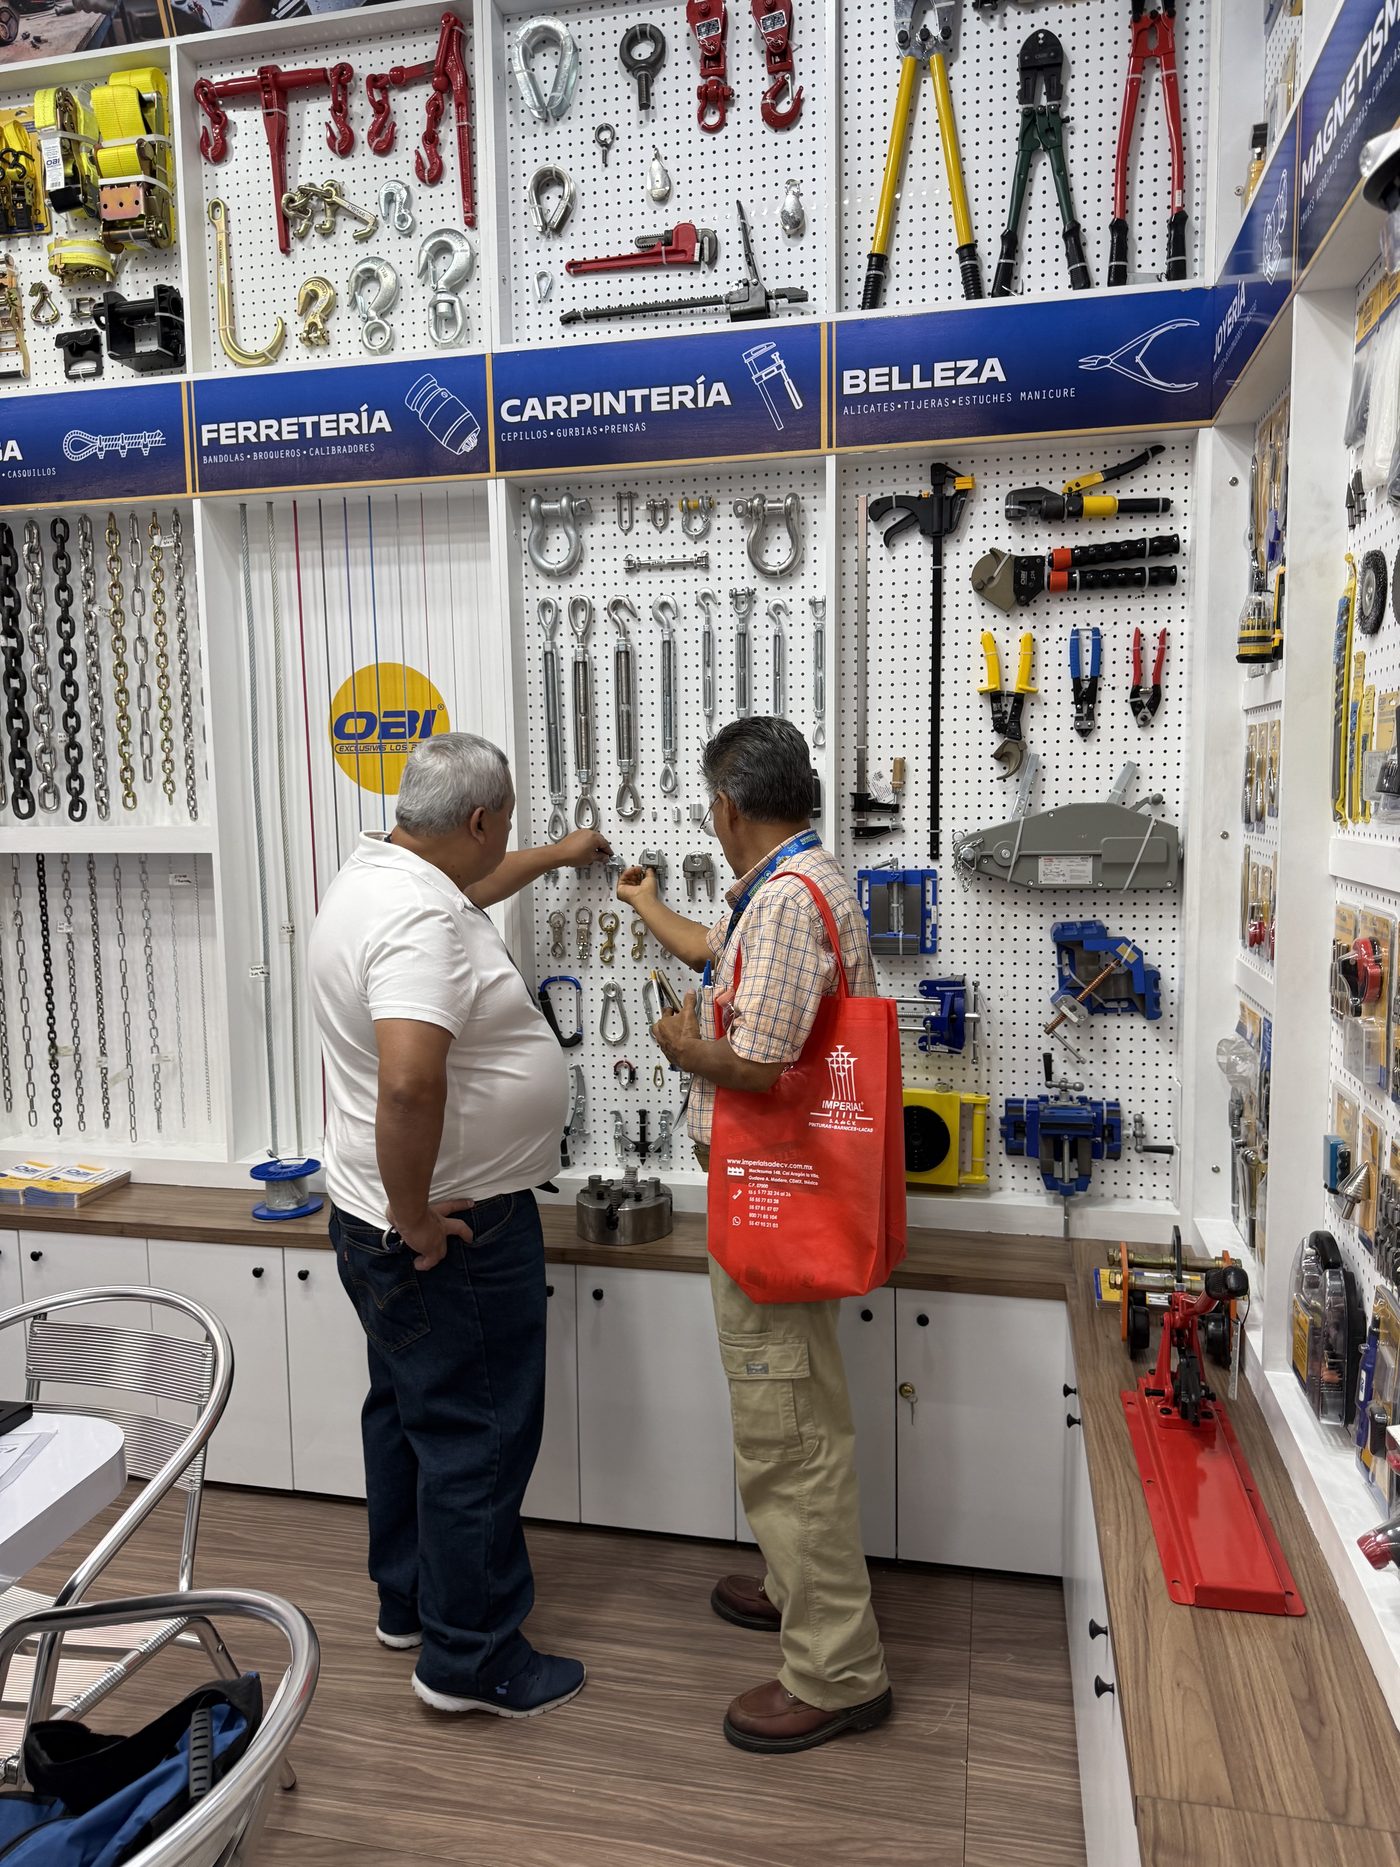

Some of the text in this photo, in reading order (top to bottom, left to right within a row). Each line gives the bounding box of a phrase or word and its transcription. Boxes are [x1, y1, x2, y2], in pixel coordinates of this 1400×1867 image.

[1213, 279, 1246, 362] JOYERÍA
[843, 357, 1006, 395] BELLEZA
[500, 375, 732, 423] CARPINTERÍA
[843, 387, 1076, 415] ALICATES TIJERAS ESTUCHES MANICURE
[201, 403, 392, 447] FERRETERÍA
[501, 422, 647, 442] CEPILLOS GURBIAS PRENSAS
[0, 439, 23, 463] A
[203, 443, 375, 464] BANDOLAS BROQUEROS CALIBRADORES
[7, 467, 57, 479] CASQUILLOS
[333, 709, 437, 741] OBI
[822, 1100, 864, 1112] IMPERIAL
